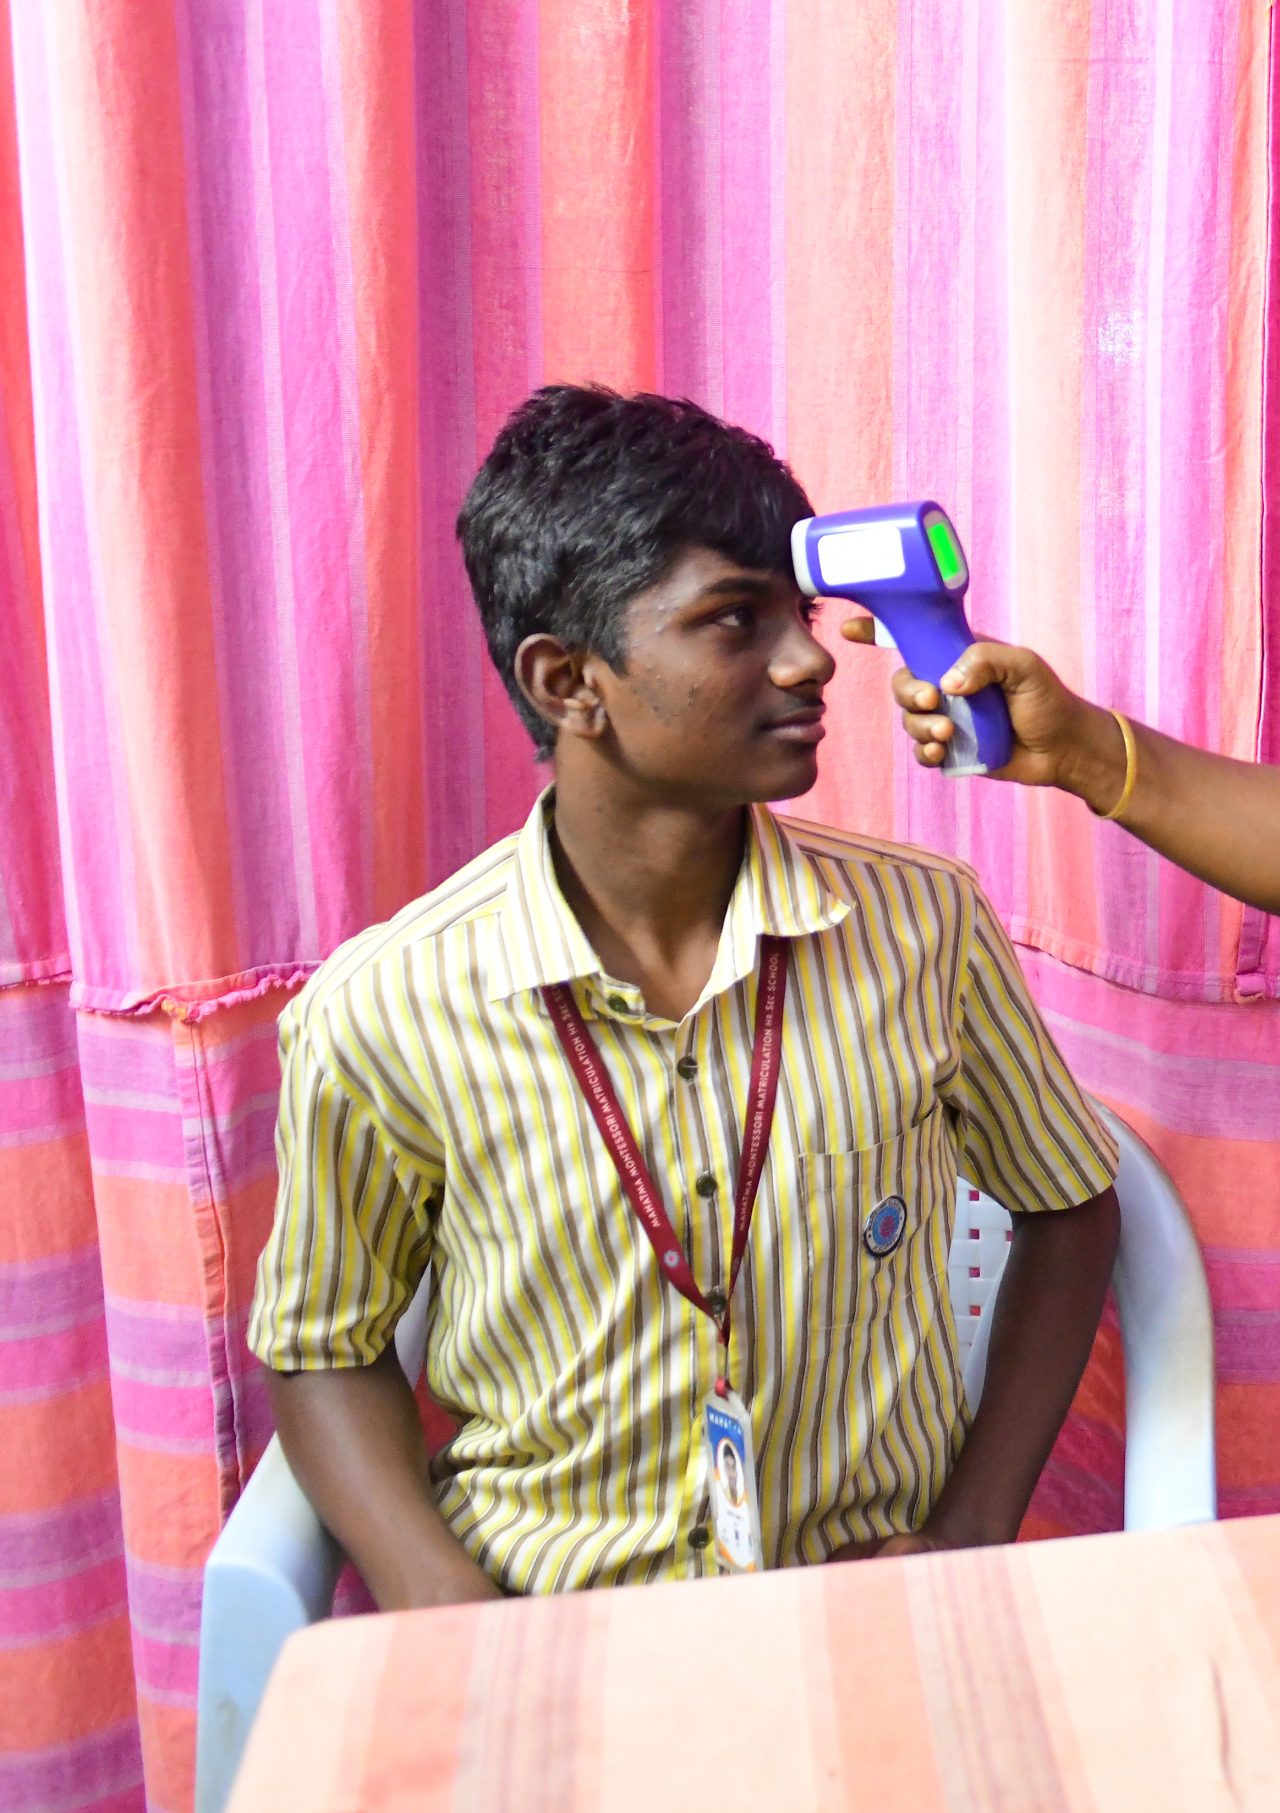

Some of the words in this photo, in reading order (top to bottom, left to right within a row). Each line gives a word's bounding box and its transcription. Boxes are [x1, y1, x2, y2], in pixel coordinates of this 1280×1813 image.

[572, 1036, 612, 1114] MATRICULATION
[747, 1111, 763, 1178] MONTESSORI
[757, 1028, 773, 1109] MATRICULATION
[604, 1113, 639, 1177] MONTESSORI
[634, 1177, 661, 1228] MAHATMA
